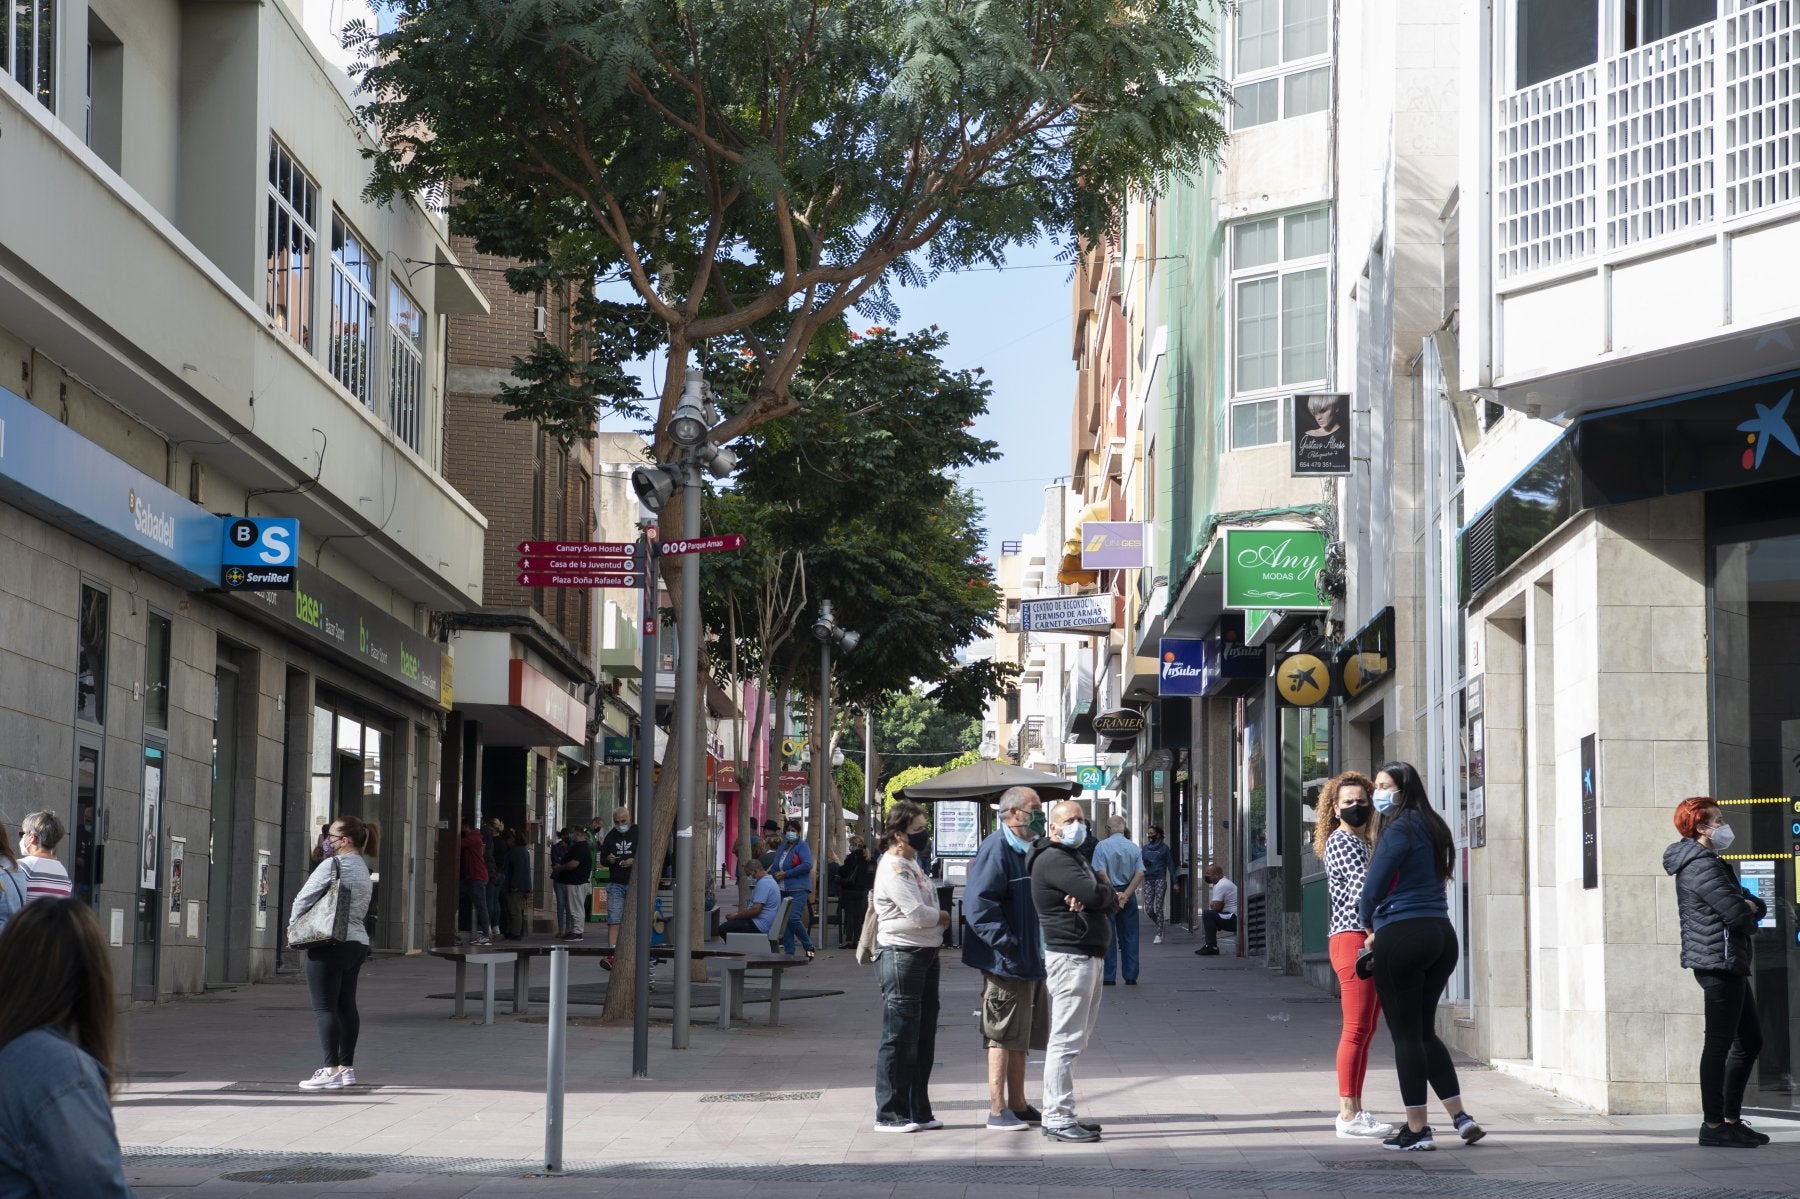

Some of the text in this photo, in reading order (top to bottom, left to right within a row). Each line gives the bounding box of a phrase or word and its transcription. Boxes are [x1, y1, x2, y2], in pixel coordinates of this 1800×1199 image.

[135, 497, 174, 550] Sabadell
[237, 526, 290, 564] B S
[556, 544, 582, 553] Canary
[1238, 539, 1318, 580] Any
[246, 572, 290, 582] ServiRed
[1033, 602, 1053, 612] CENTRO
[1055, 602, 1061, 610] DE
[1036, 611, 1065, 620] PERMISO
[1077, 608, 1101, 617] ARMAS
[1035, 621, 1060, 629] CARNET
[1162, 662, 1201, 680] Insular
[1095, 718, 1144, 728] GRANIER
